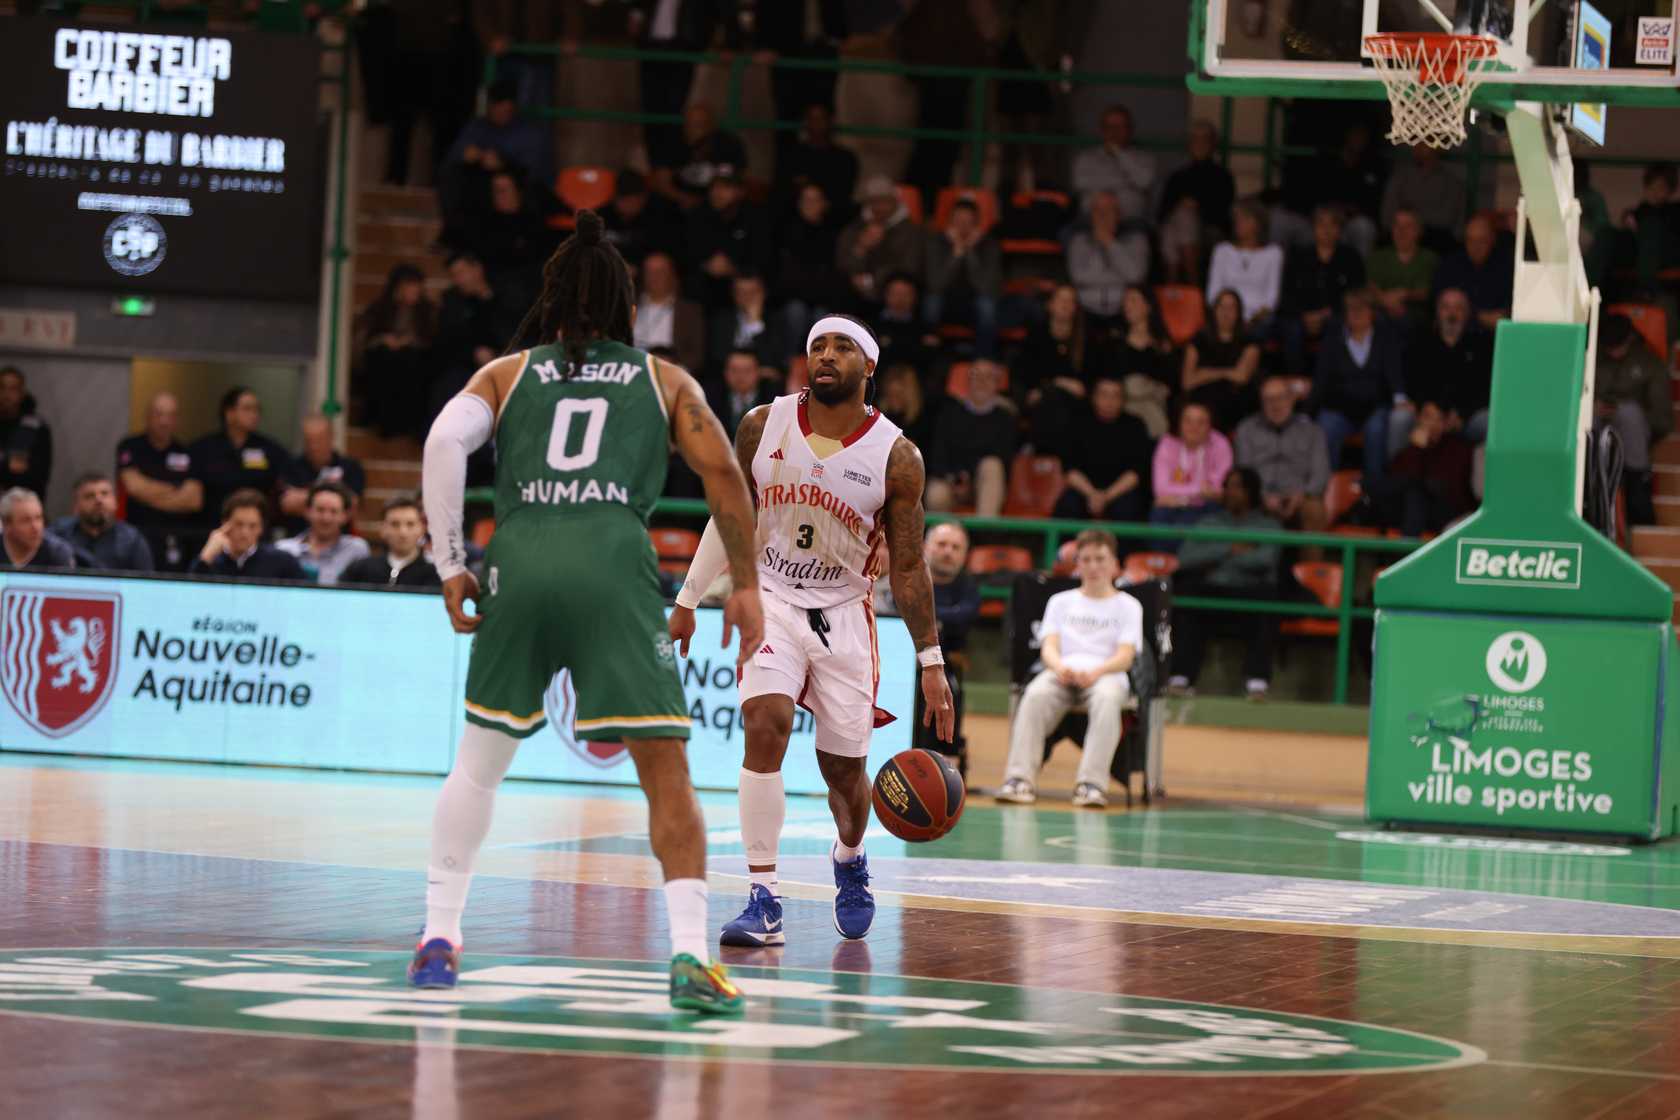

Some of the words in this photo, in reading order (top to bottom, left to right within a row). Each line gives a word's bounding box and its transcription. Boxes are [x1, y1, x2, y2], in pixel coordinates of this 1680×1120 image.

[54, 28, 232, 80] COIFFEUR
[67, 70, 215, 118] BARBIER
[546, 397, 608, 471] 0
[517, 478, 628, 505] HUMAN
[796, 524, 814, 550] 3
[764, 546, 842, 581] Stradim
[1466, 548, 1571, 580] Betclic
[133, 629, 315, 667] Nouvelle-
[133, 668, 311, 713] Aquitaine
[1431, 742, 1592, 781] LIMOGES
[1407, 774, 1473, 805] ville
[1481, 783, 1613, 815] sportive
